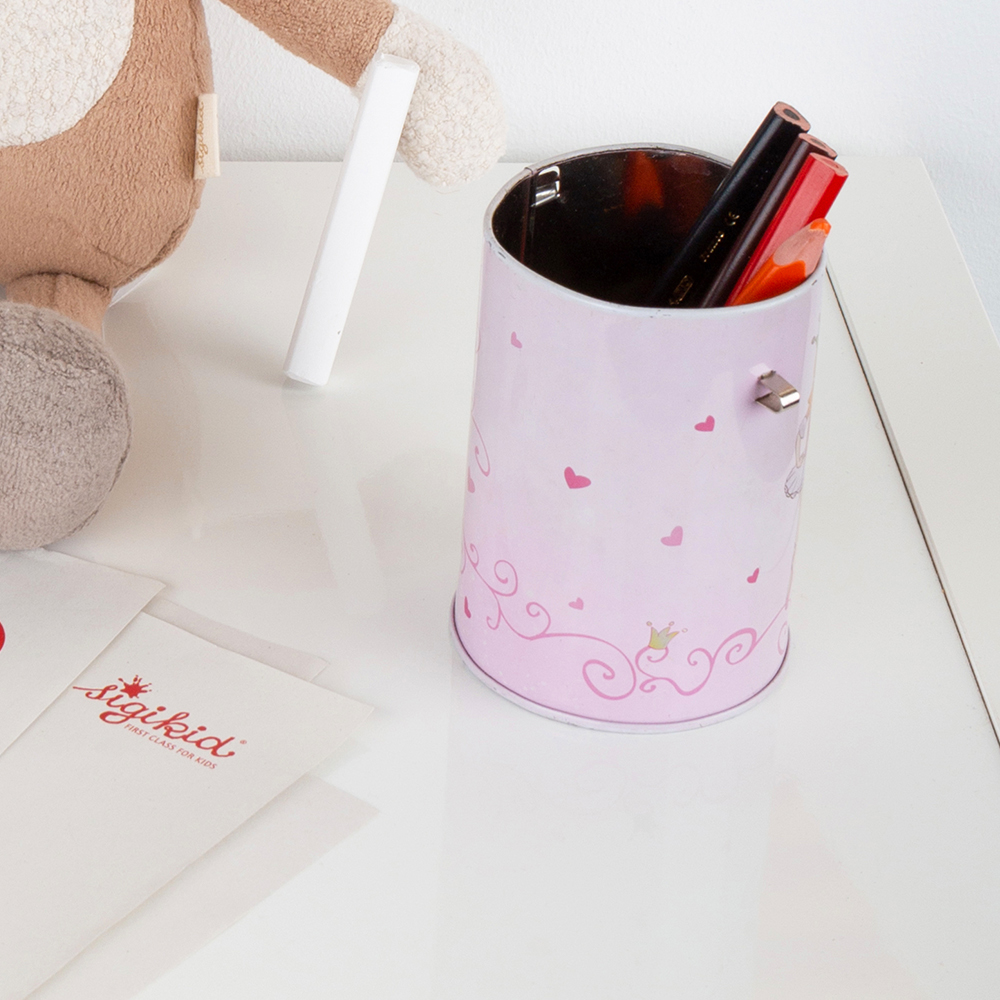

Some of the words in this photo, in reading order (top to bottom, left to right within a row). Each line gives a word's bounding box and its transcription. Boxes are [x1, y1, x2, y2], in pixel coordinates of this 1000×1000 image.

[124, 723, 150, 738] FIRST
[149, 735, 177, 751] CLASS
[176, 747, 195, 760] FOR
[195, 756, 218, 770] KIDS
